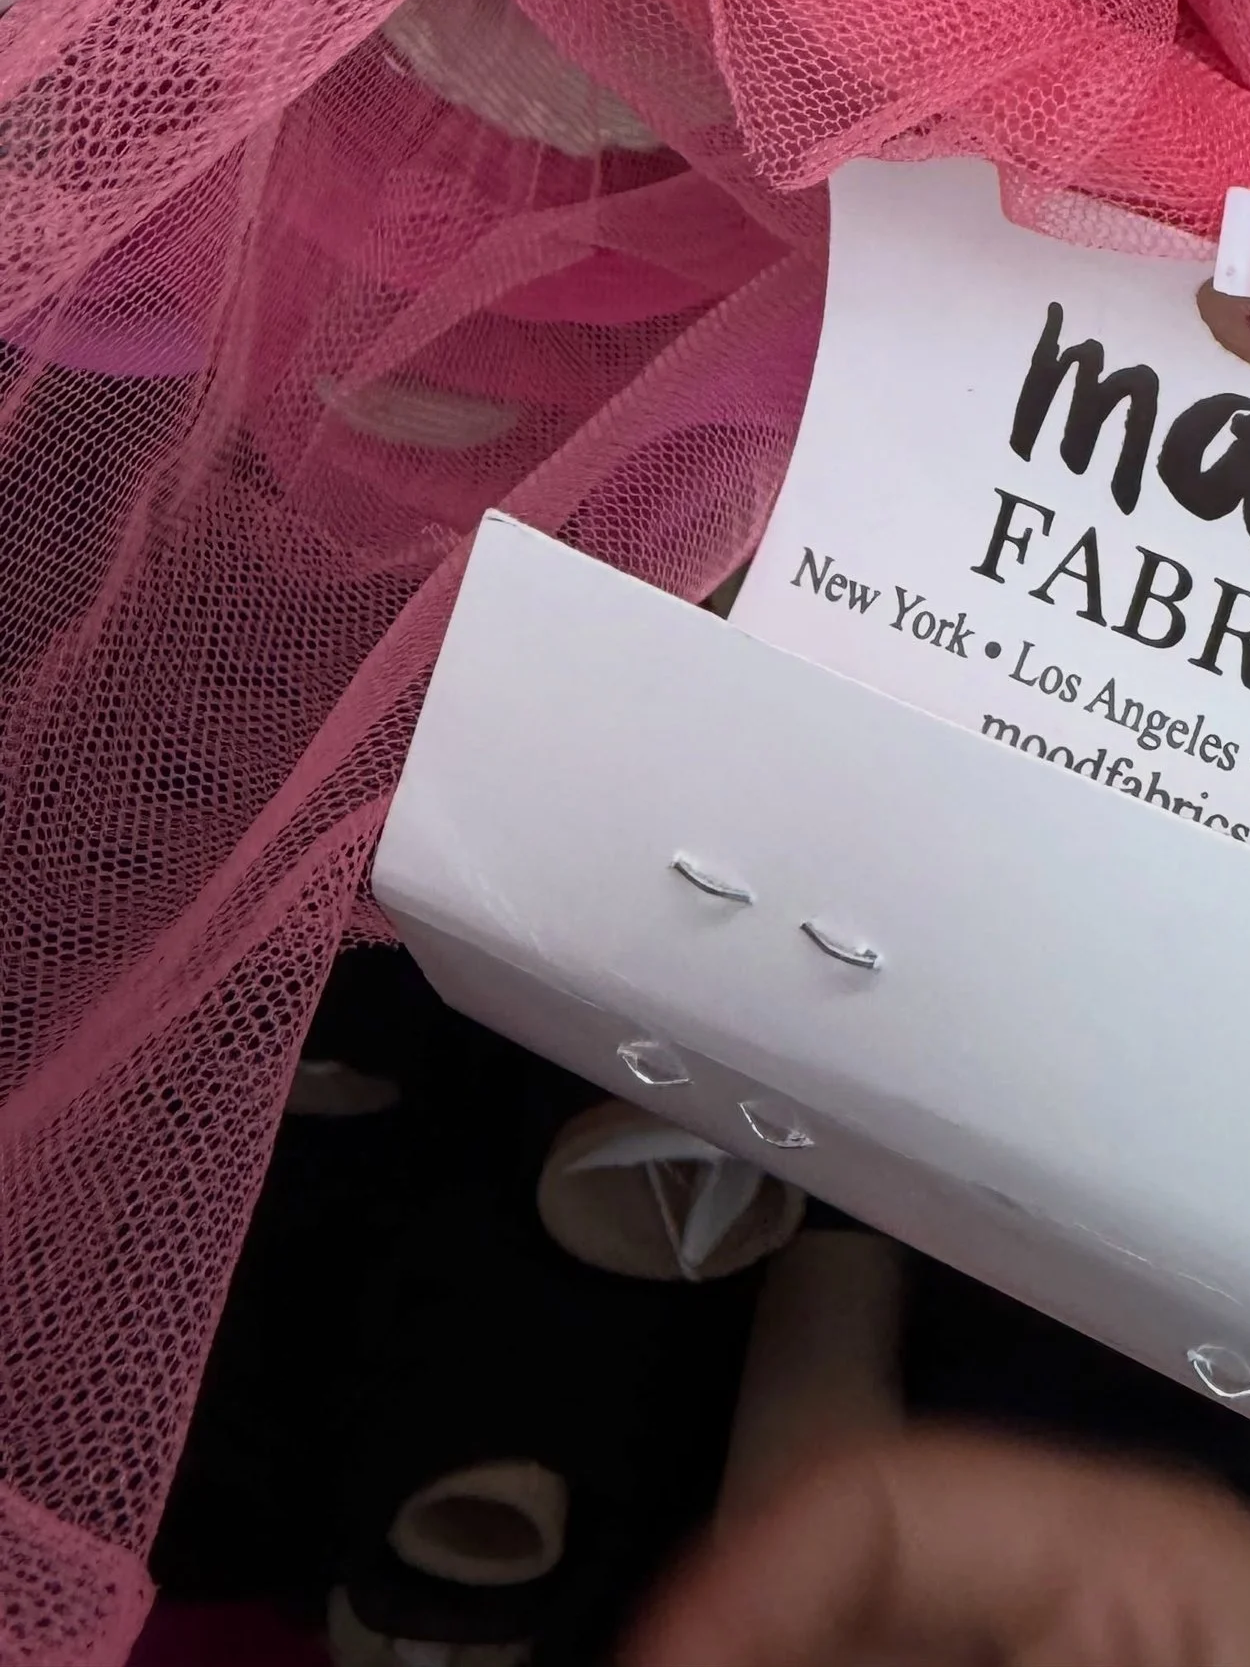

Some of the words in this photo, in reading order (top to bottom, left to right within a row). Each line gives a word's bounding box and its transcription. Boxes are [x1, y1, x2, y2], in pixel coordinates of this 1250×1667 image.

[790, 547, 881, 615] New
[889, 585, 975, 659] York
[1008, 641, 1082, 703] Los
[1083, 677, 1240, 771] Angeles
